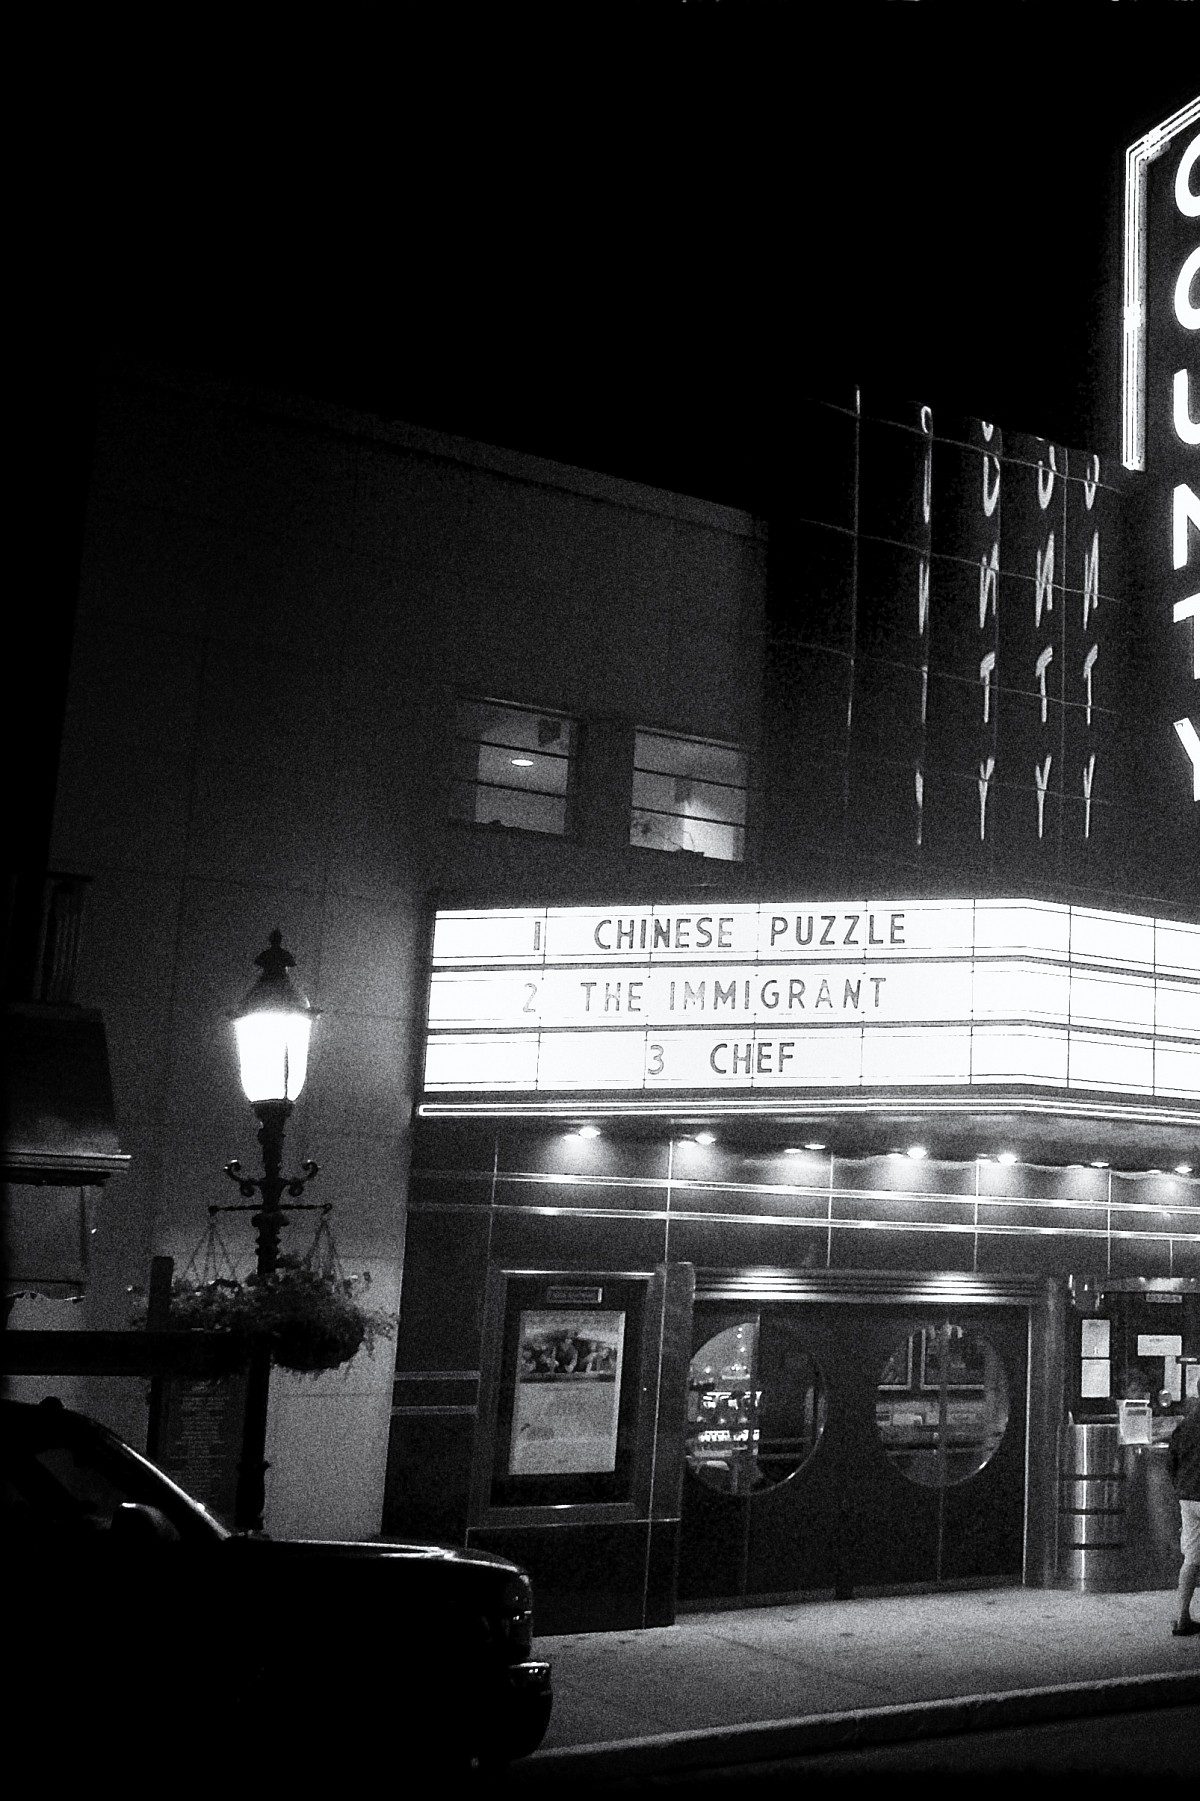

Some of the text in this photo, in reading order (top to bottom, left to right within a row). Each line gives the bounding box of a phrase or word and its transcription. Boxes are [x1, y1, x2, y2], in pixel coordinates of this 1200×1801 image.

[594, 915, 734, 950] CHINESE
[770, 912, 907, 947] PUZZLE
[523, 976, 888, 1014] 2 THE IMMIGRANT
[647, 1042, 796, 1076] 3 CHEF
